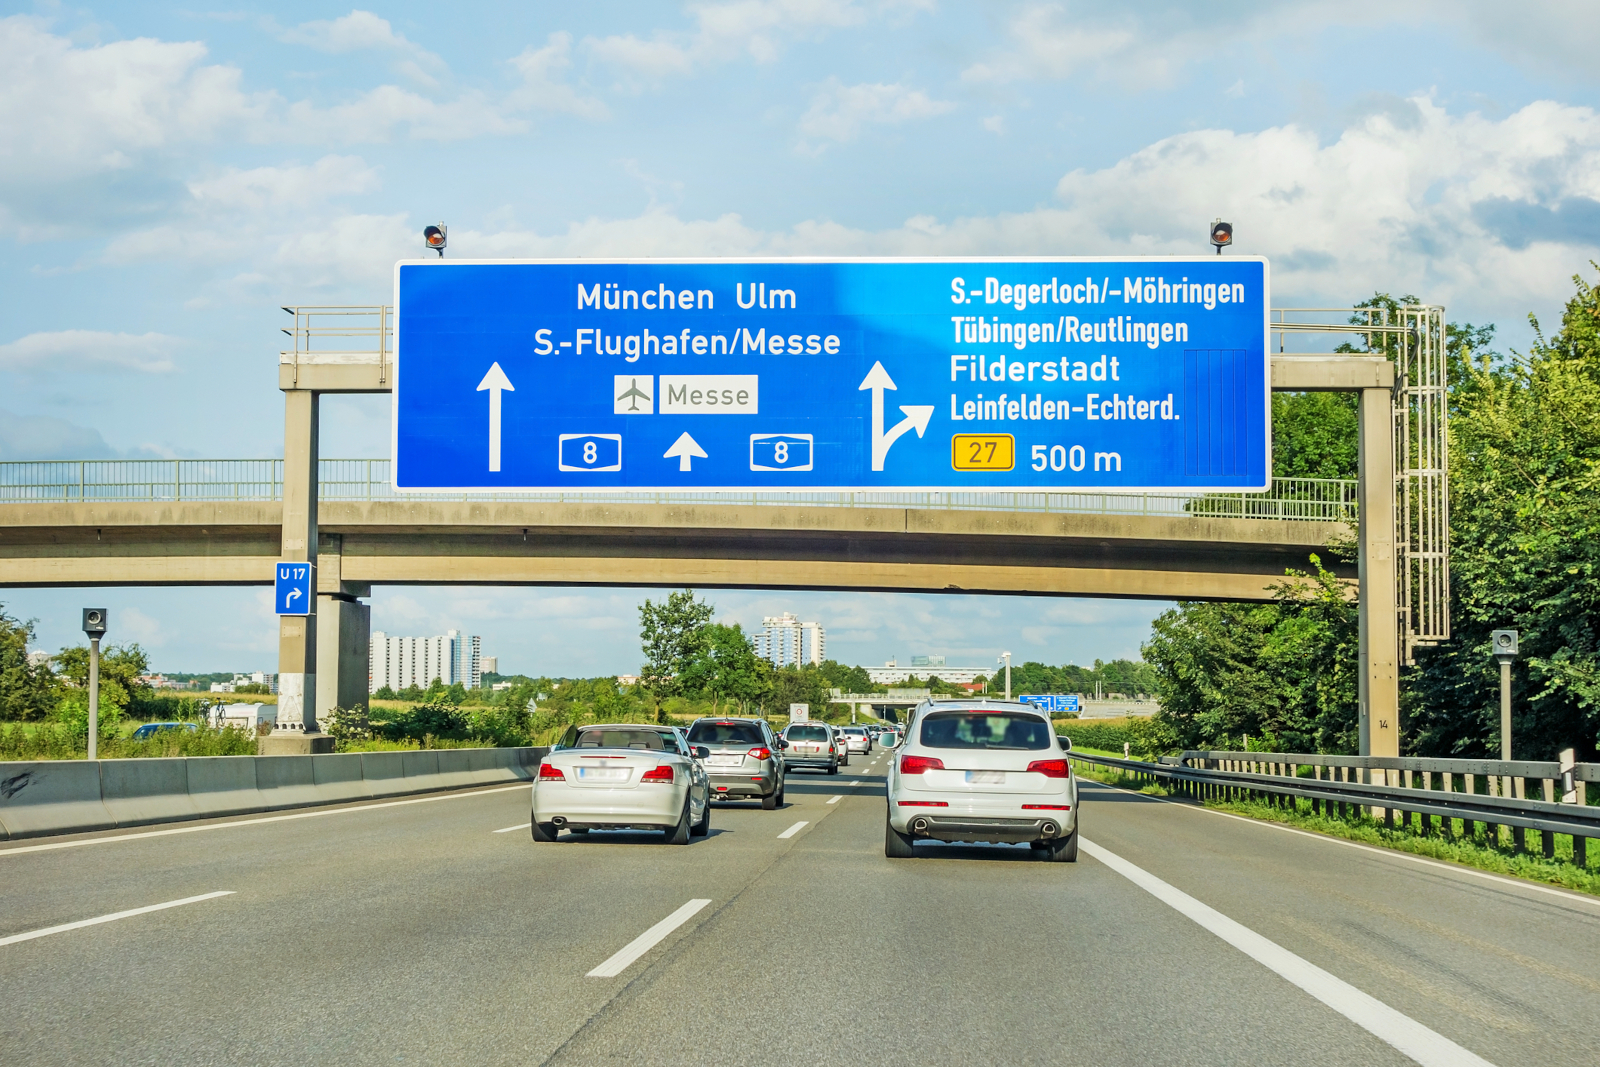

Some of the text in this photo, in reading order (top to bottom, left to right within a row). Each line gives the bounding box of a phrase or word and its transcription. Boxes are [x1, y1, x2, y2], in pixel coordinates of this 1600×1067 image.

[577, 282, 796, 310] München Ulm
[950, 276, 1245, 311] S.-Degerloch/-Möhringen
[533, 327, 841, 363] S.-Flughafen/Messe
[950, 315, 1189, 350] Tübingen/Reutlingen
[950, 354, 1120, 382] Filderstadt
[668, 383, 749, 406] Messe
[950, 393, 1180, 421] Leinfelden-Echterd.
[583, 441, 598, 465] 8
[774, 441, 790, 465] 8
[969, 441, 998, 464] 27
[1031, 444, 1122, 472] 500 m
[280, 568, 306, 580] U 17
[1379, 719, 1389, 729] 14
